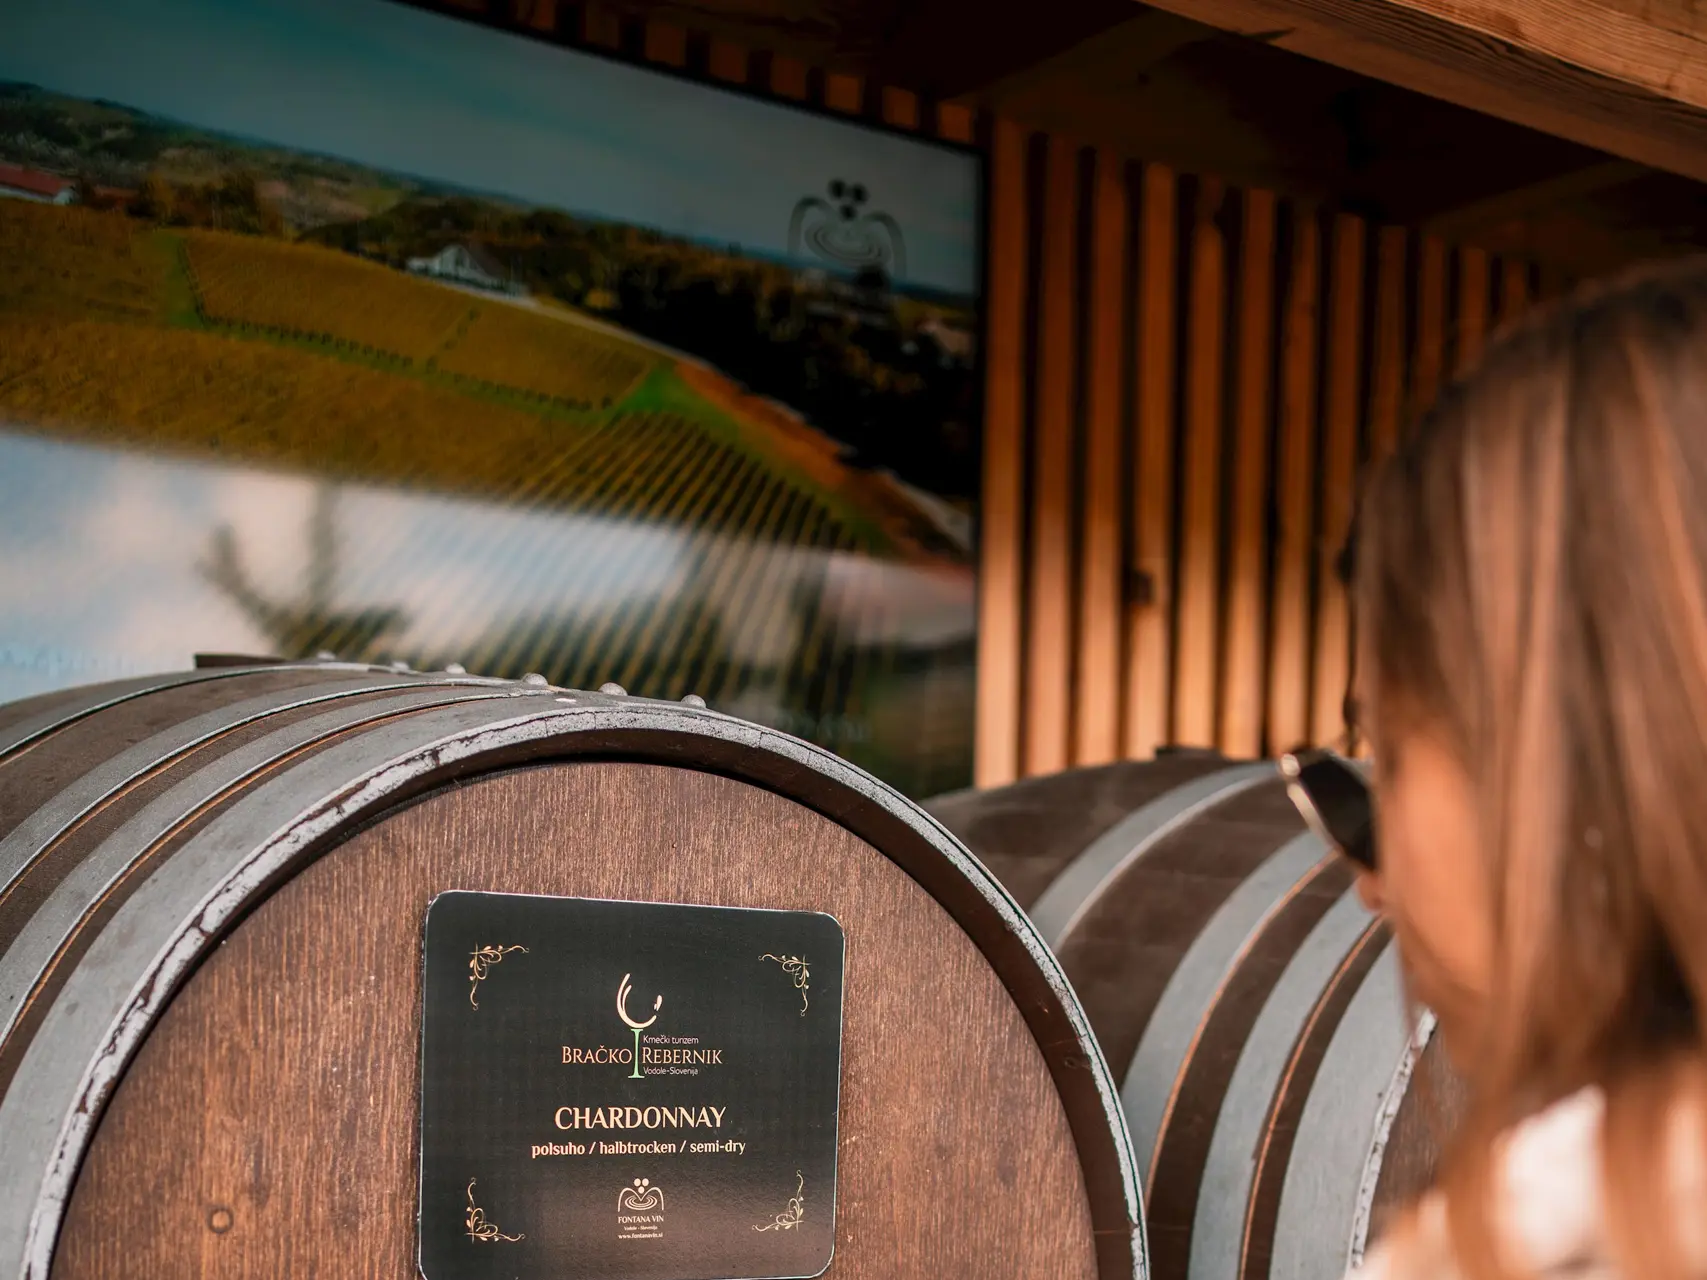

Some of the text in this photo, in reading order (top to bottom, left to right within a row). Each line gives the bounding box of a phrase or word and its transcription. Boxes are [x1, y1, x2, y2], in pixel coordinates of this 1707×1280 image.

[641, 1047, 723, 1065] REBERNIK
[555, 1106, 726, 1130] CHARDONNAY
[531, 1142, 586, 1159] polsuho
[599, 1140, 677, 1155] halbtrocken
[689, 1139, 747, 1156] semi-dry
